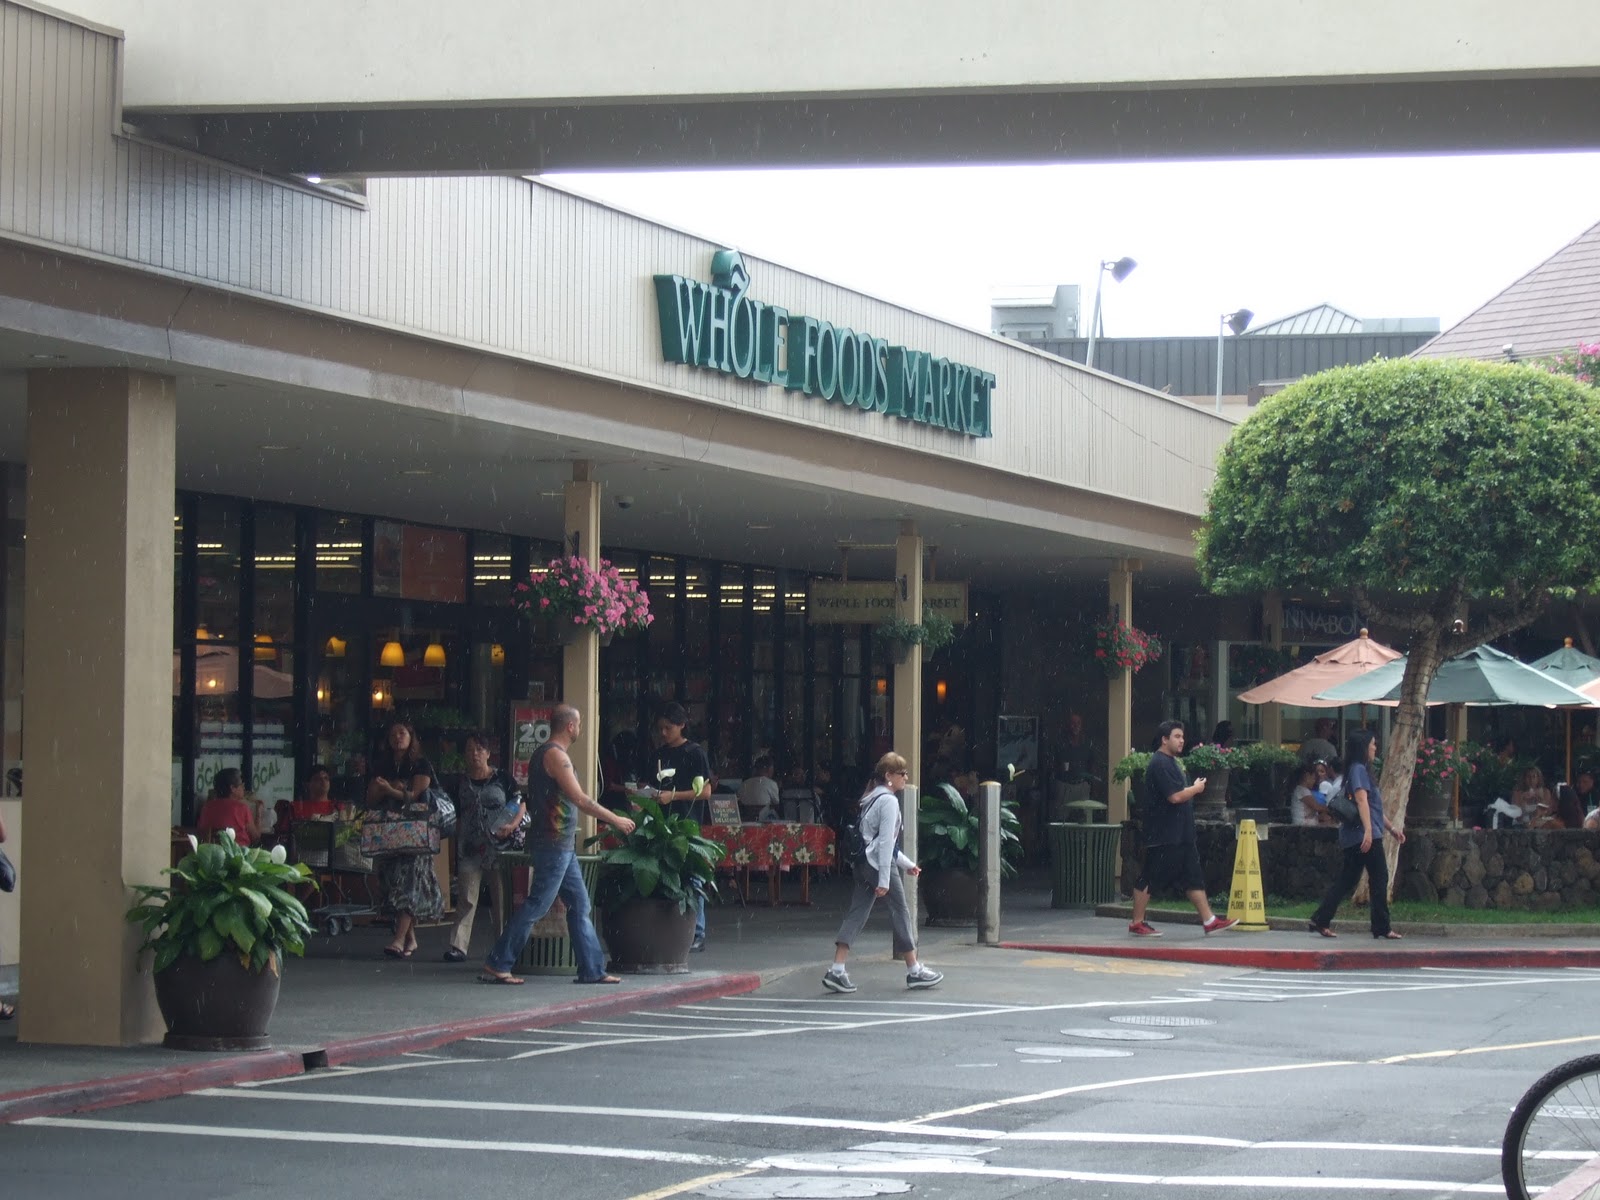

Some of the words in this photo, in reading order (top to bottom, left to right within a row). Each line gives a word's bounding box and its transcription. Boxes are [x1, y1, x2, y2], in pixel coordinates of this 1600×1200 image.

[655, 264, 790, 388] WHOLE
[802, 315, 890, 415] FOODS
[898, 345, 997, 438] MARKET
[816, 597, 861, 609] WHOLE
[921, 597, 960, 609] ARKET
[1282, 606, 1369, 635] INNABON
[519, 723, 551, 744] 20
[1234, 890, 1243, 899] WET
[1250, 891, 1259, 899] WET
[1230, 901, 1245, 910] FLOOR
[1248, 902, 1262, 910] FLOOR
